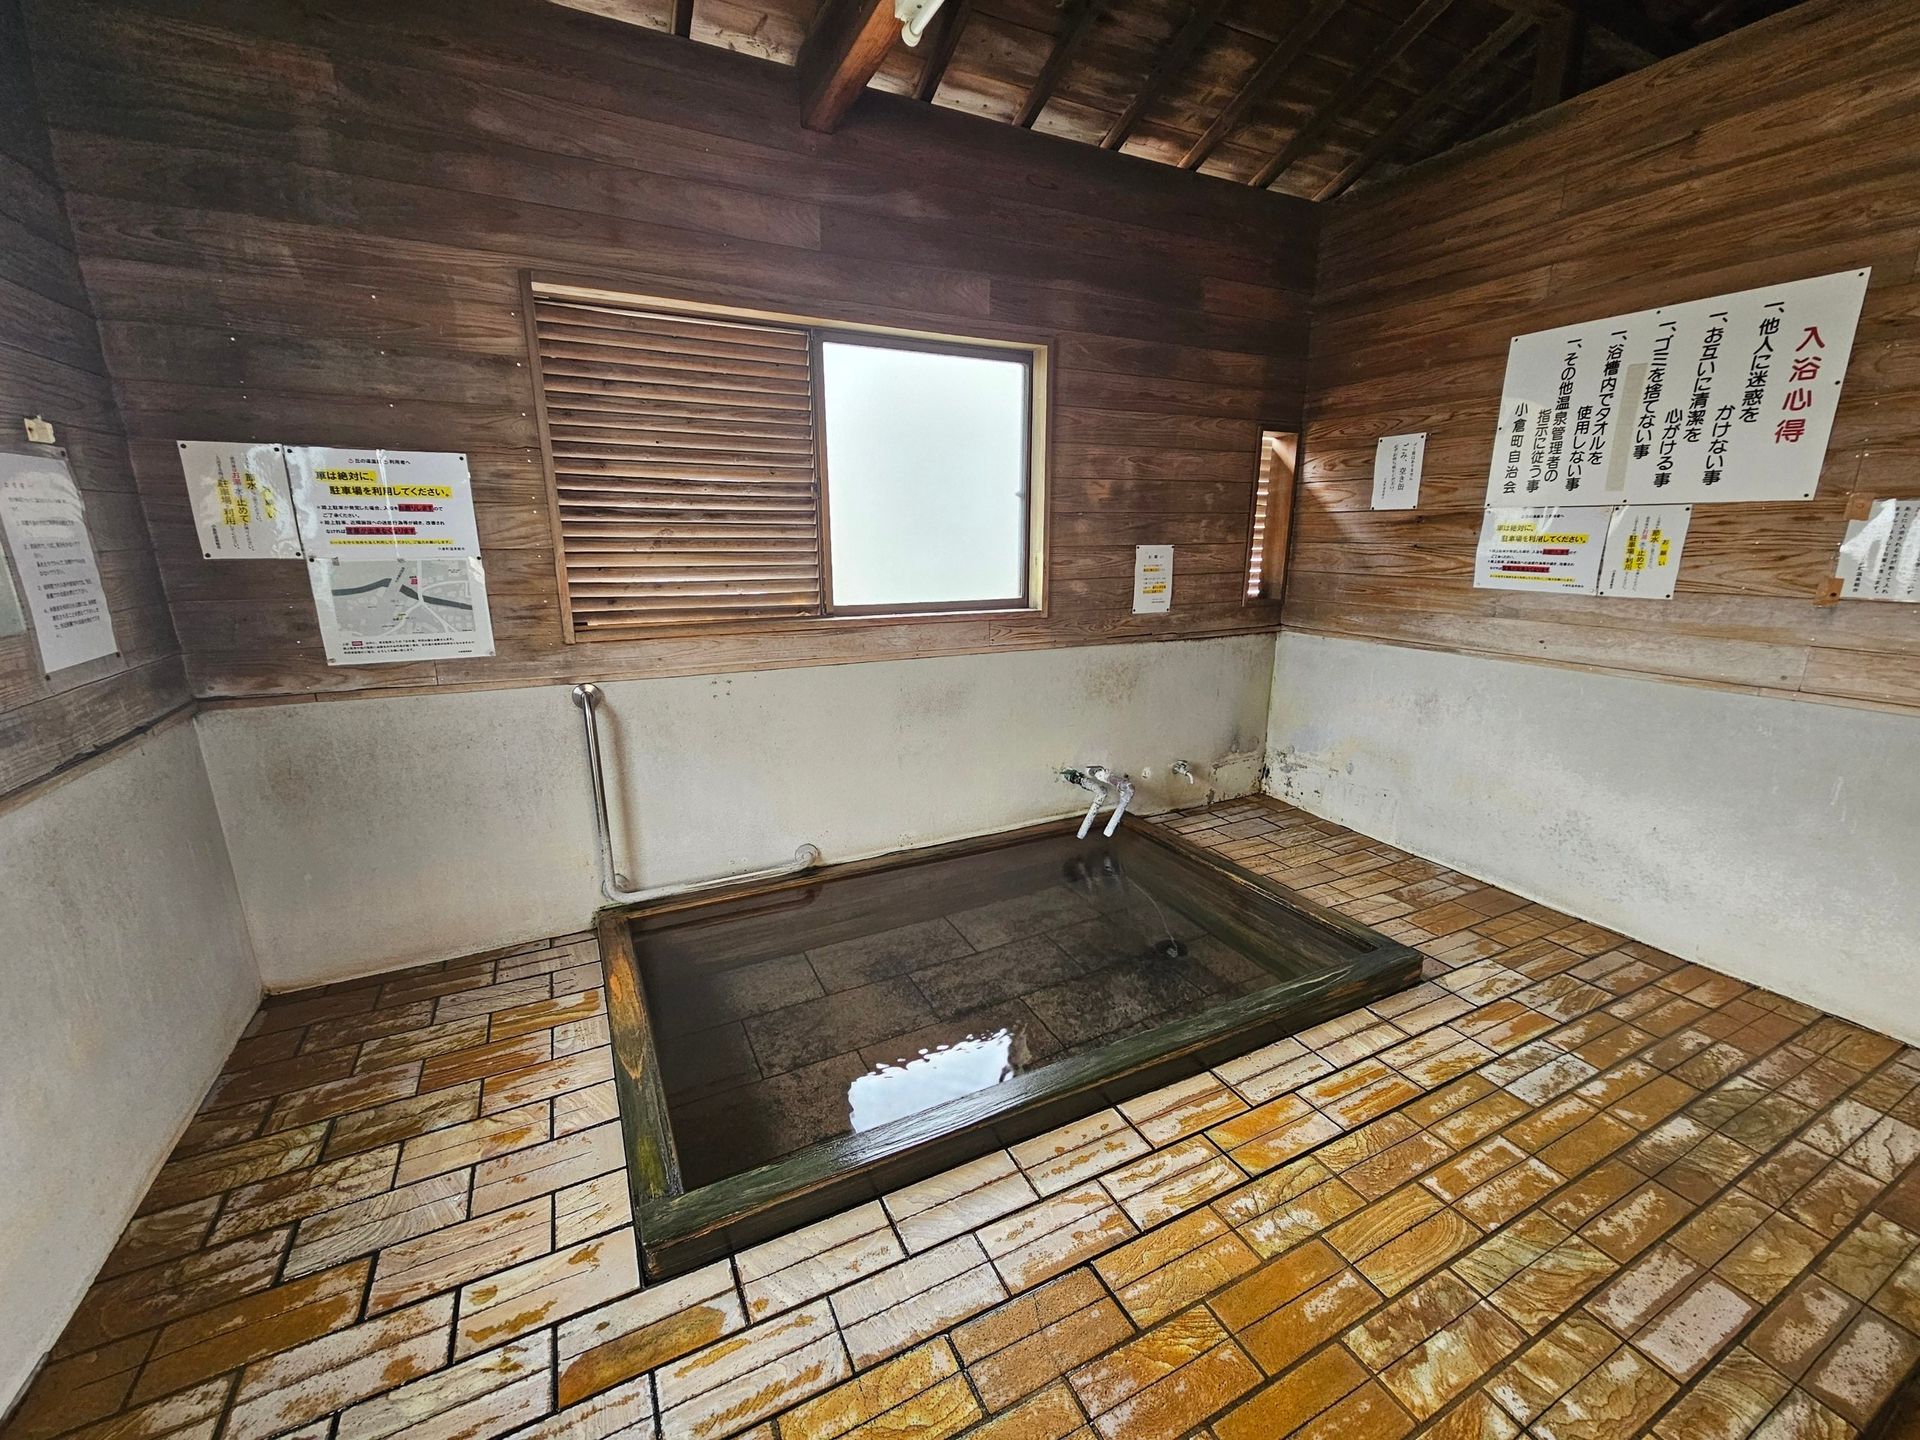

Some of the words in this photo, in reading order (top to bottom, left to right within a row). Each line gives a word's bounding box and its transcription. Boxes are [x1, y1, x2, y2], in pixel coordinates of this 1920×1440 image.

[1586, 329, 1627, 465] 一、浴槽内でタオルを
[1632, 320, 1677, 460] 一、ゴミを捨てない事
[1683, 311, 1728, 443] 一、お互いに清潔を
[1738, 301, 1785, 423] 一、他人に迷惑を
[1774, 326, 1826, 444] 入浴心得
[1503, 402, 1529, 494] 小倉町自治会
[1525, 408, 1552, 493] 指示に従う事
[1543, 338, 1582, 482] 一、その他温泉管理者の
[1565, 405, 1593, 491] 使用しない事
[1653, 407, 1682, 488] 心がける事
[1702, 404, 1735, 486] かけない事
[316, 471, 374, 482] 車は絶対に、
[329, 485, 450, 498] 駐車場を利用してください。
